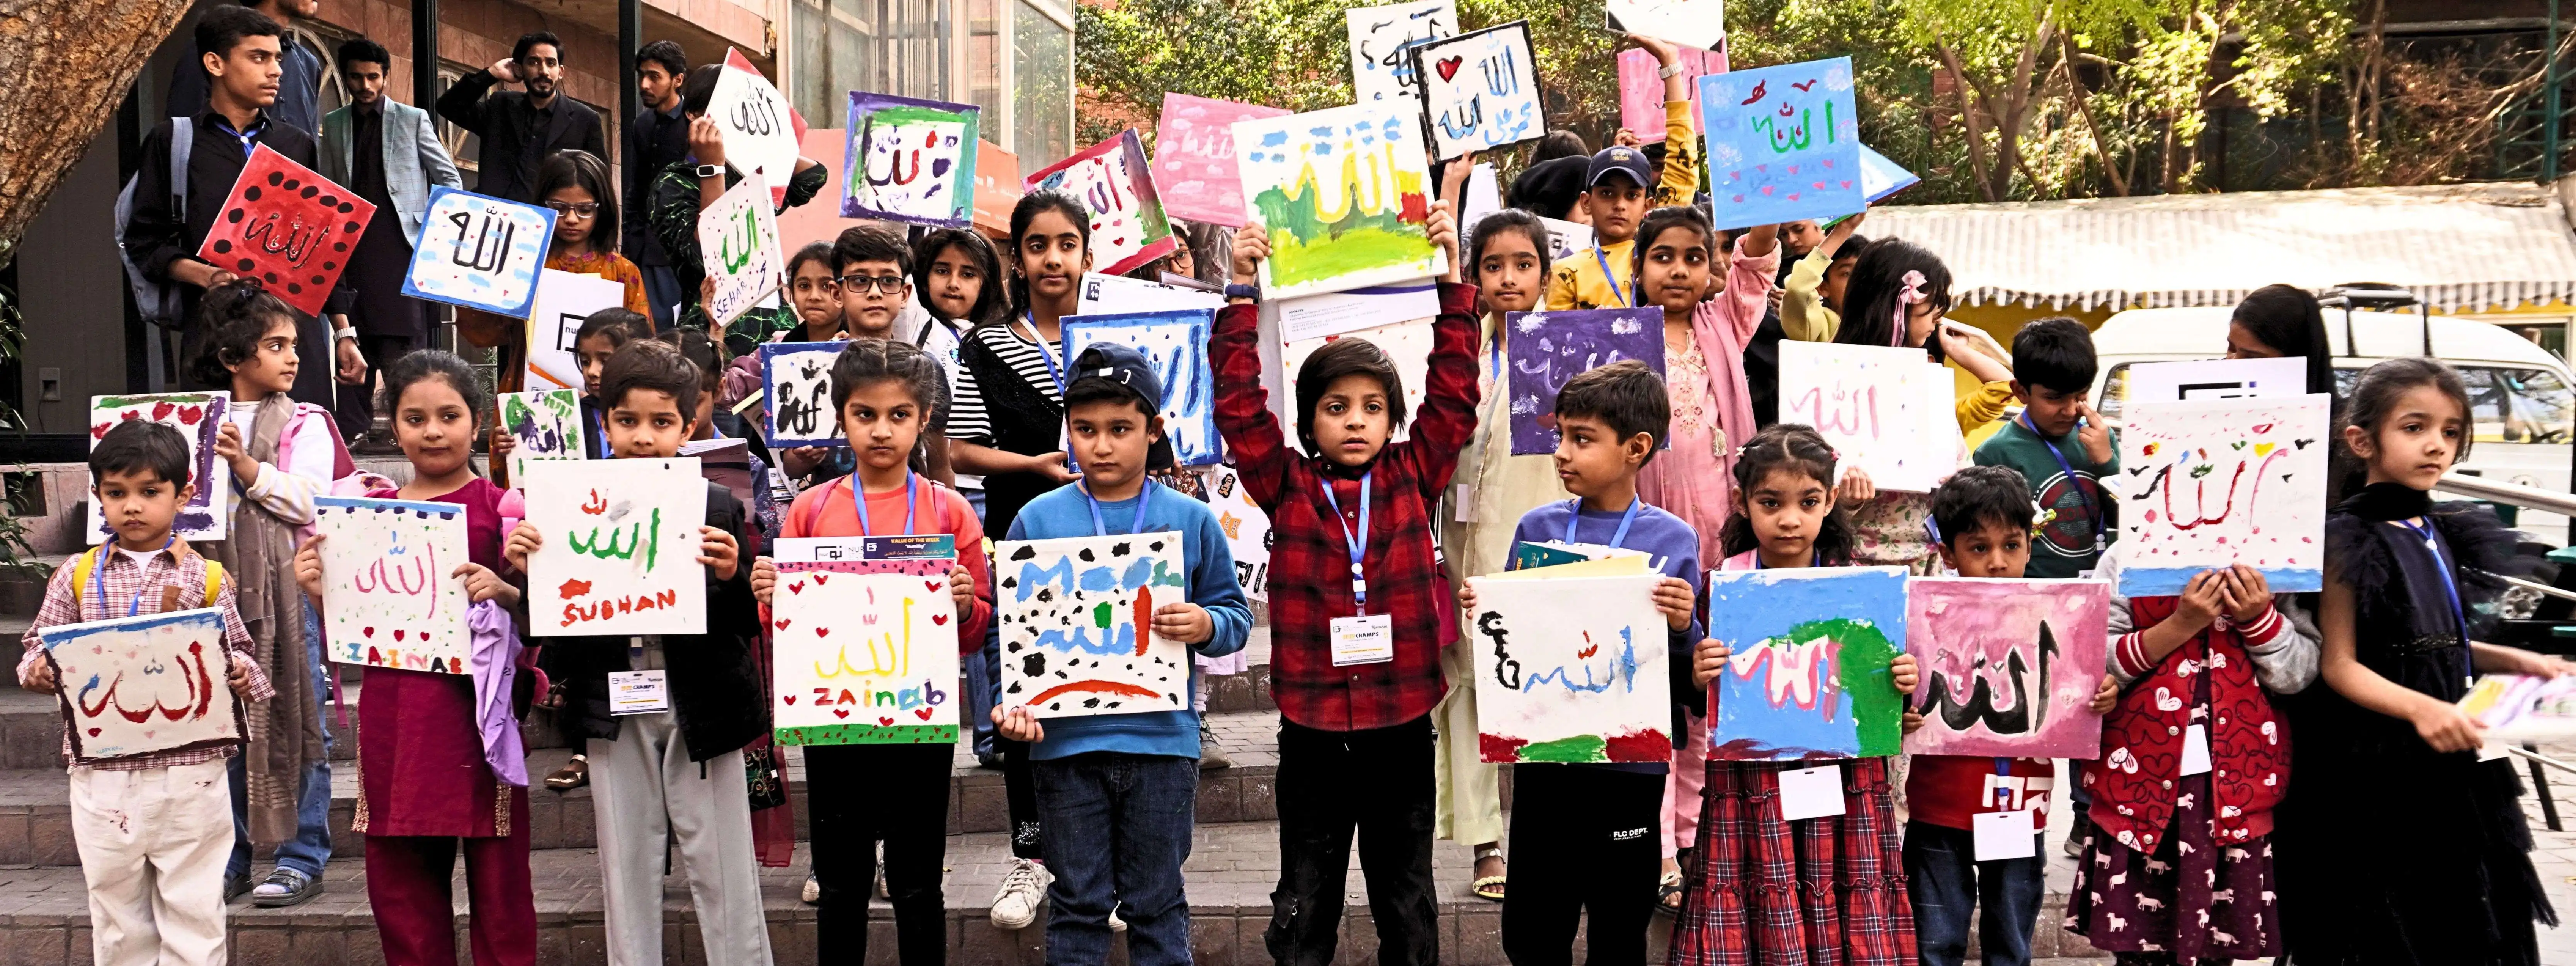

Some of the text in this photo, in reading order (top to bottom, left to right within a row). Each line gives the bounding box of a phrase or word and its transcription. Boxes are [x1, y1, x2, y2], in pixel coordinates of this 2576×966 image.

[716, 281, 747, 318] SEHAR
[561, 588, 676, 628] SUBHAN
[347, 641, 463, 675] ZAINAB
[1630, 828, 1648, 836] DEPT.
